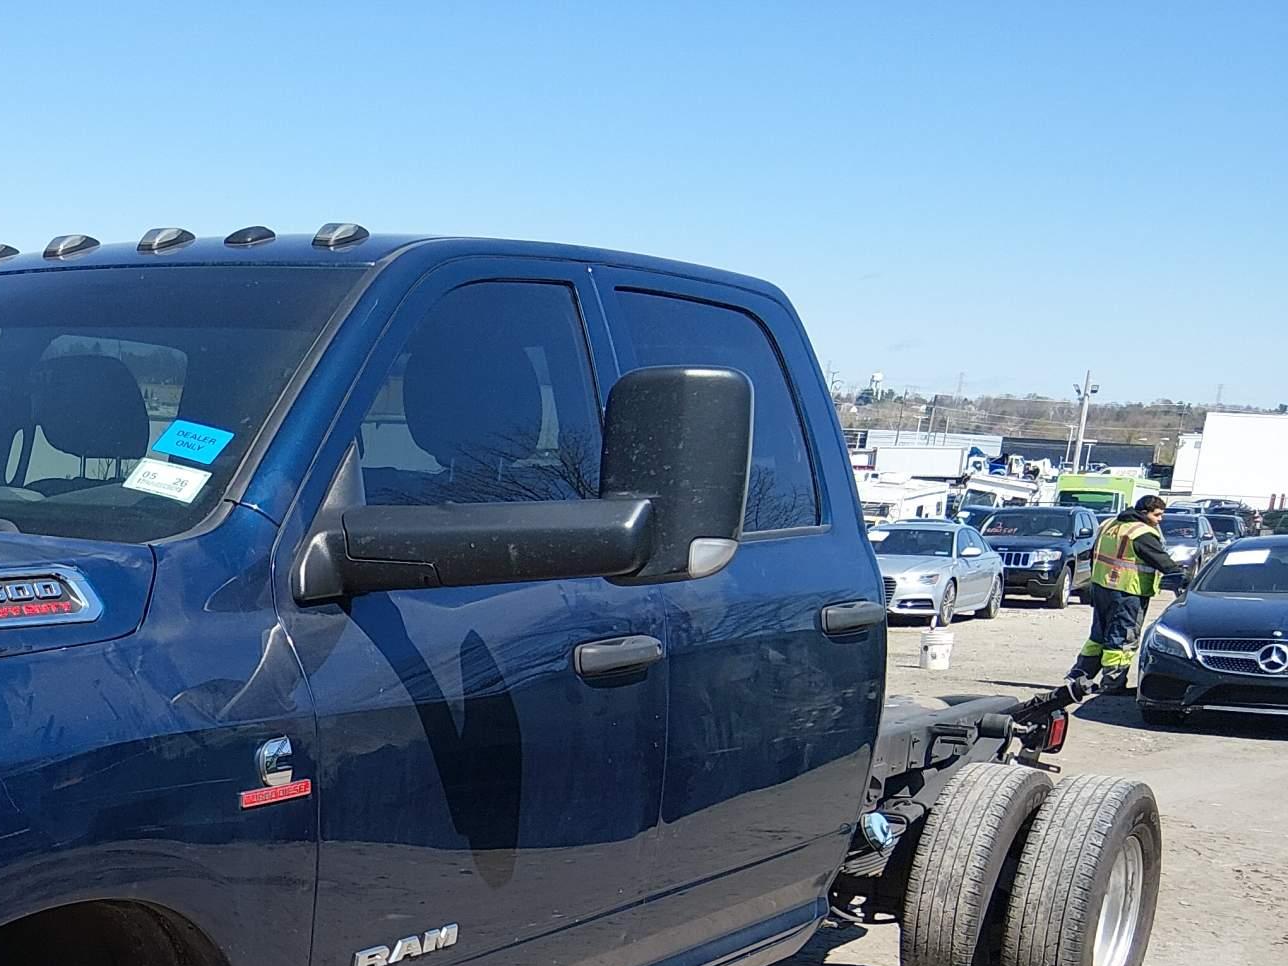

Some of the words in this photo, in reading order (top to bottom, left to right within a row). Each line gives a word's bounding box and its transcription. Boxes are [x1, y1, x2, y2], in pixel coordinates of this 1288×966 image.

[175, 440, 205, 452] ONLY
[176, 430, 217, 446] DEALER
[142, 470, 159, 481] 05
[172, 477, 189, 488] 26
